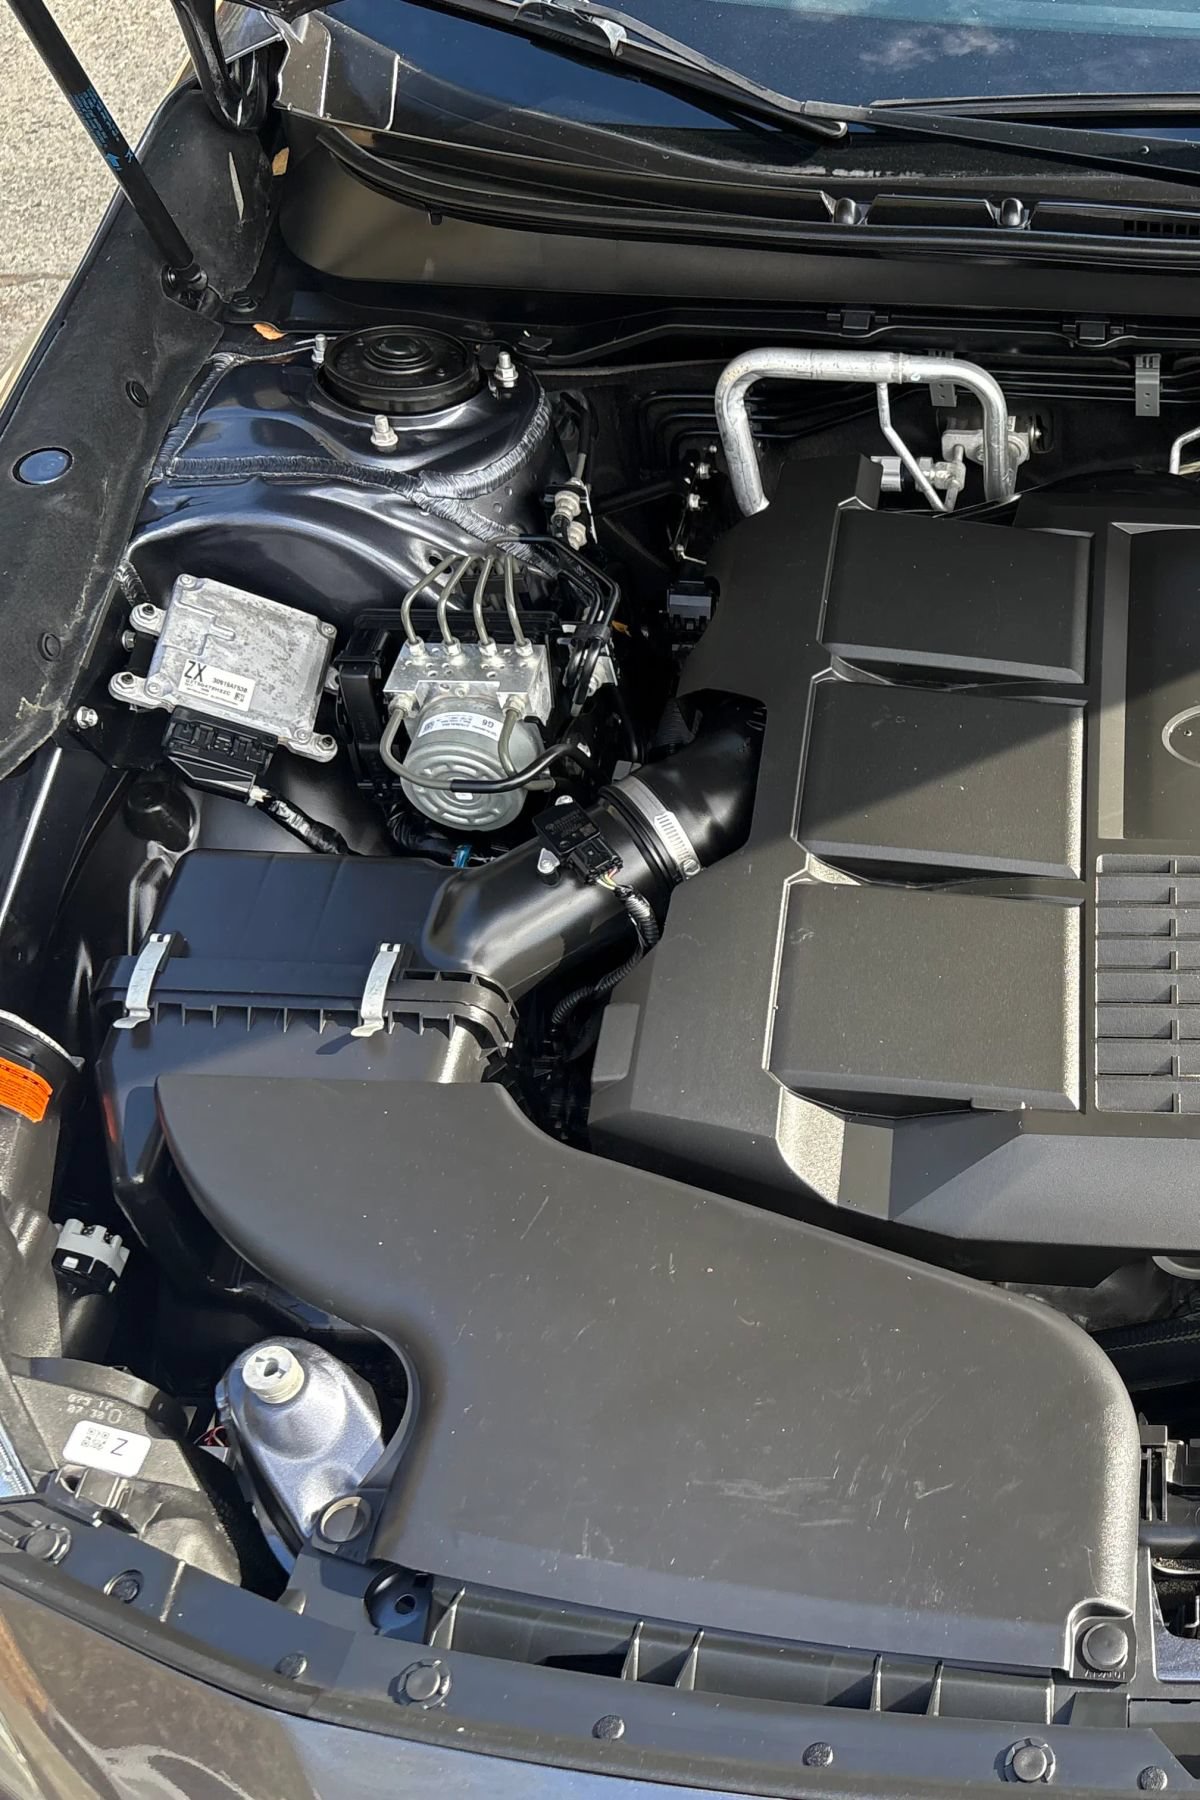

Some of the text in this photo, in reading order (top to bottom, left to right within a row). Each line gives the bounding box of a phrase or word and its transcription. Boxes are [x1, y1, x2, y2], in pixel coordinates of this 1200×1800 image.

[184, 660, 207, 682] ZX
[481, 718, 495, 729] G6
[110, 1437, 128, 1457] Z
